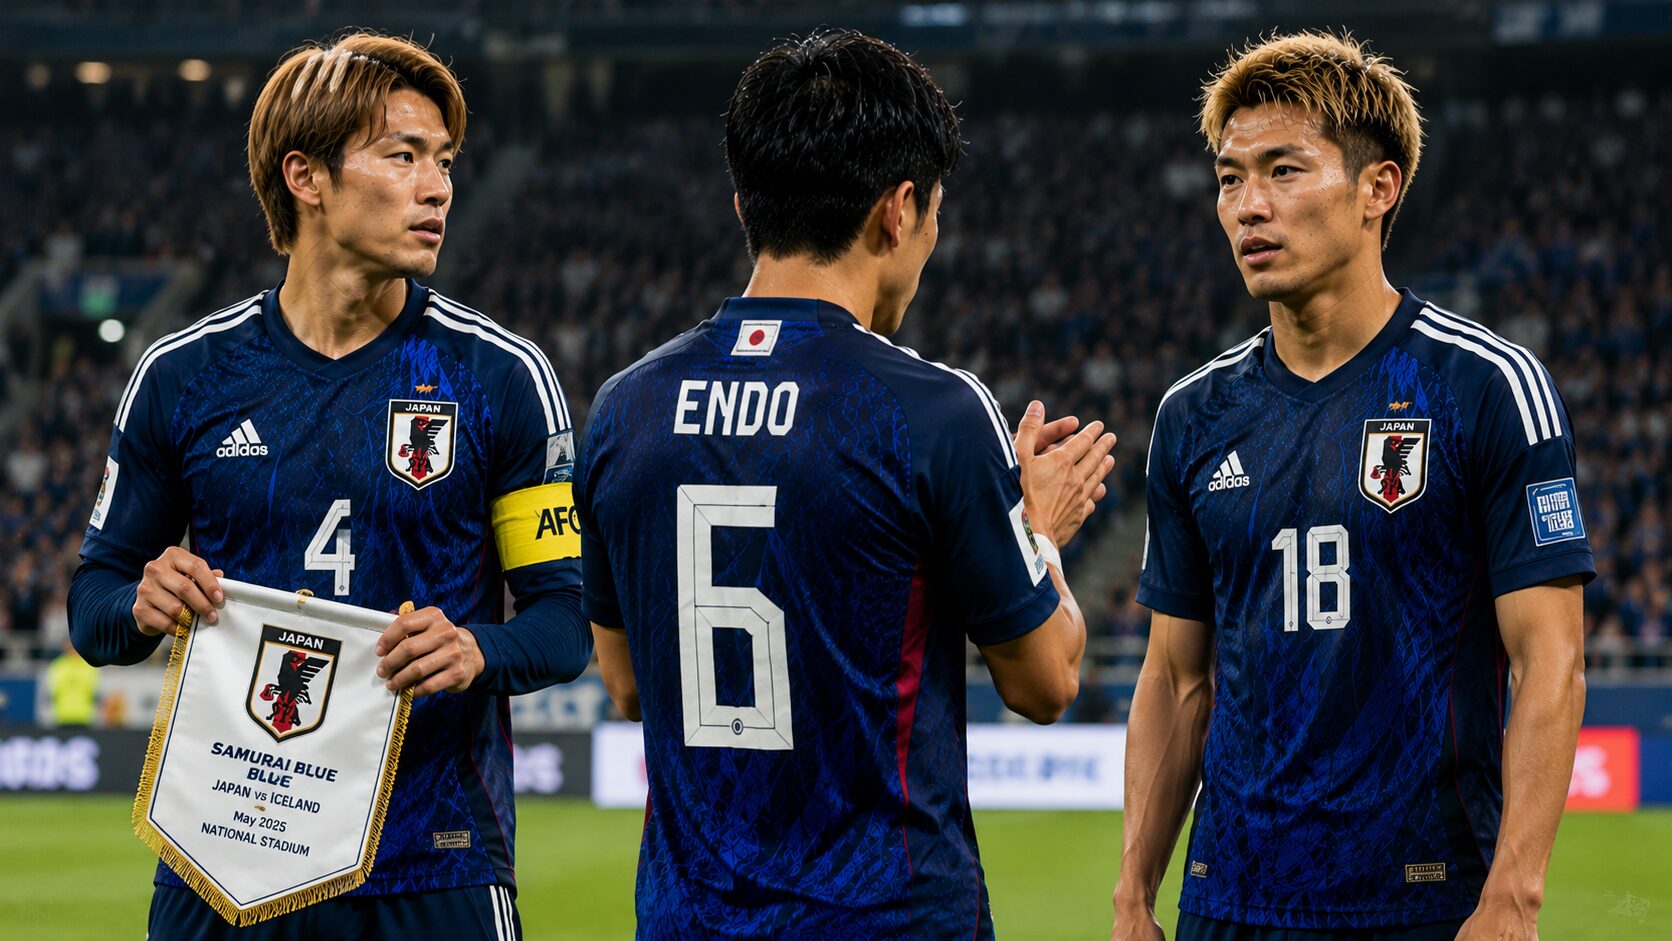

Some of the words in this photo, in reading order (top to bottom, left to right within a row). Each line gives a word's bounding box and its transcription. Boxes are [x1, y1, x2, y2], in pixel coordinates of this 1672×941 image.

[405, 403, 441, 413] JAPAN
[674, 379, 800, 436] ENDO
[1379, 422, 1415, 432] JAPAN
[216, 443, 269, 458] adidas
[1208, 474, 1250, 492] adidas
[304, 499, 355, 596] 4
[1271, 524, 1351, 632] 18
[677, 484, 794, 750] 6
[278, 631, 324, 650] JAPAN
[211, 742, 291, 771] SAMURAI
[293, 761, 338, 782] BLUE
[212, 779, 251, 798] JAPAN
[270, 792, 321, 814] ICELAND
[233, 811, 257, 827] May
[259, 817, 287, 832] 2025
[201, 822, 257, 844] NATIONAL
[260, 836, 310, 857] STADIUM
